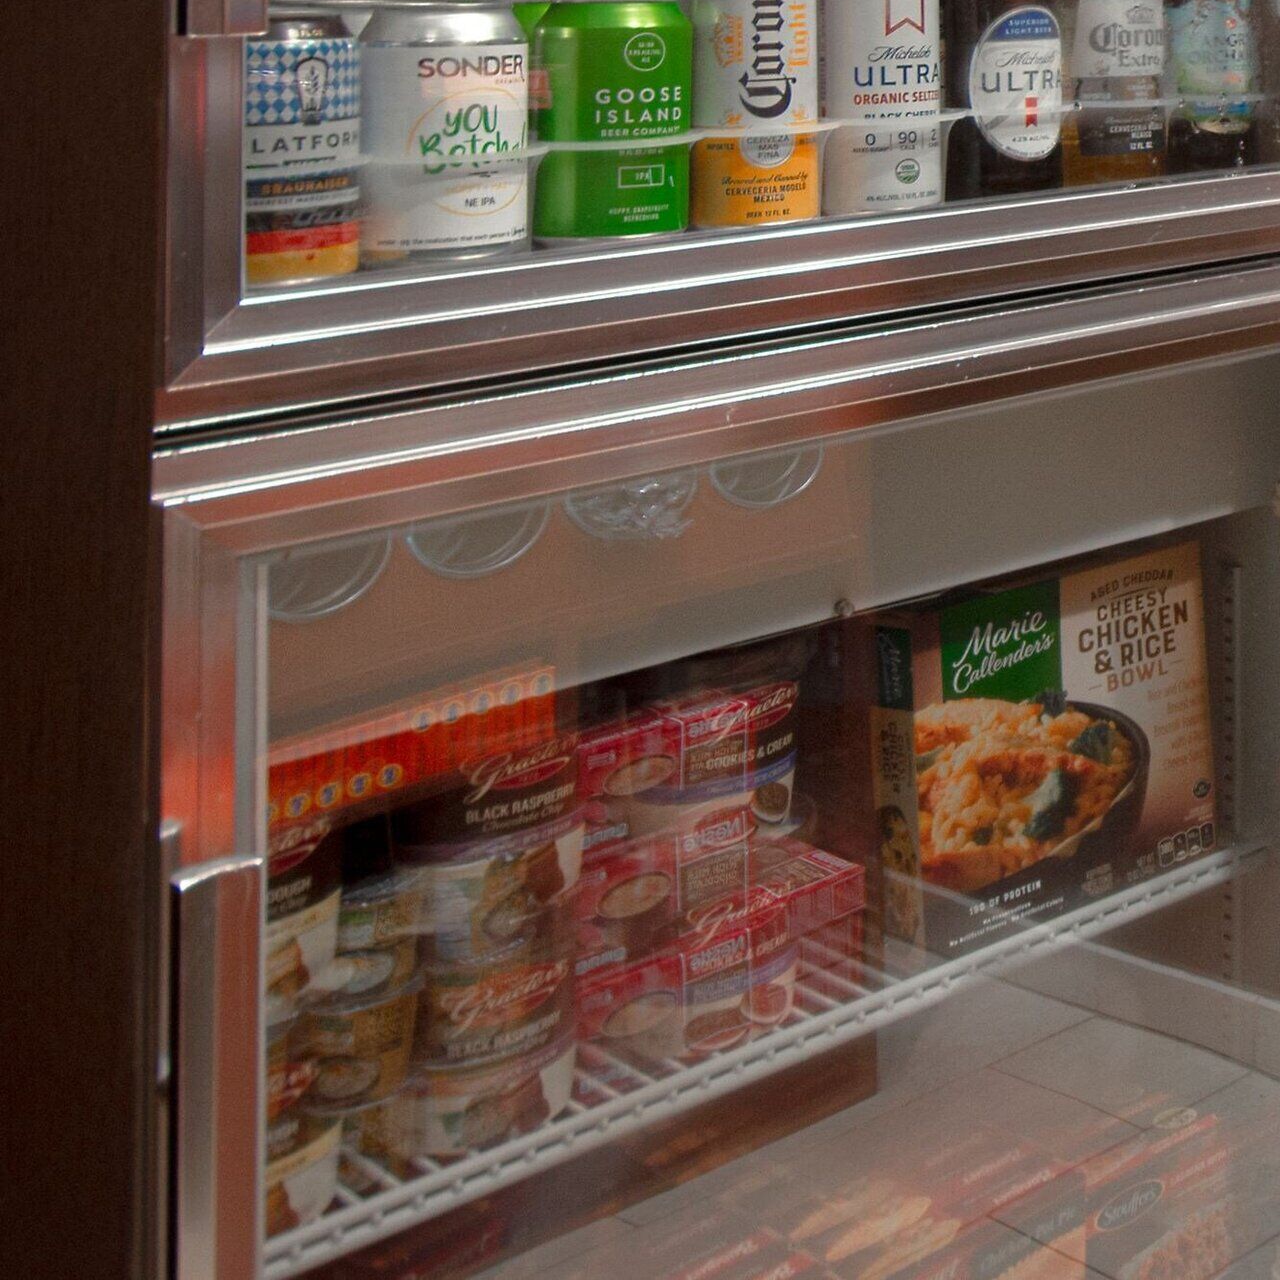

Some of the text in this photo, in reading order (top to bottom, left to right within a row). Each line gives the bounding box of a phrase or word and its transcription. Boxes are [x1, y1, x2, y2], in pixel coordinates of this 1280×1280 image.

[867, 44, 932, 63] Michelob
[1118, 49, 1162, 68] Extra
[418, 54, 526, 82] SONDER
[854, 63, 940, 87] ULTRA
[595, 86, 682, 105] GOOSE
[854, 91, 910, 106] ORGANIC
[595, 107, 682, 124] ISLAND
[600, 125, 680, 138] BEER COMPANY
[865, 131, 917, 146] 0 90
[725, 182, 806, 197] CERVECERIA MODELO
[465, 196, 496, 209] NE IPA
[1090, 569, 1174, 603] AGED CHEDDAR
[1096, 586, 1169, 622] CHEESY
[1077, 599, 1189, 654] CHICKEN
[951, 611, 1048, 669] Marie
[1094, 629, 1177, 675] & RICE
[952, 632, 1056, 694] Callender's
[1105, 659, 1169, 694] BOWL
[465, 781, 576, 825] BLACK RASPBERRY
[1002, 878, 1043, 904] PROTEIN
